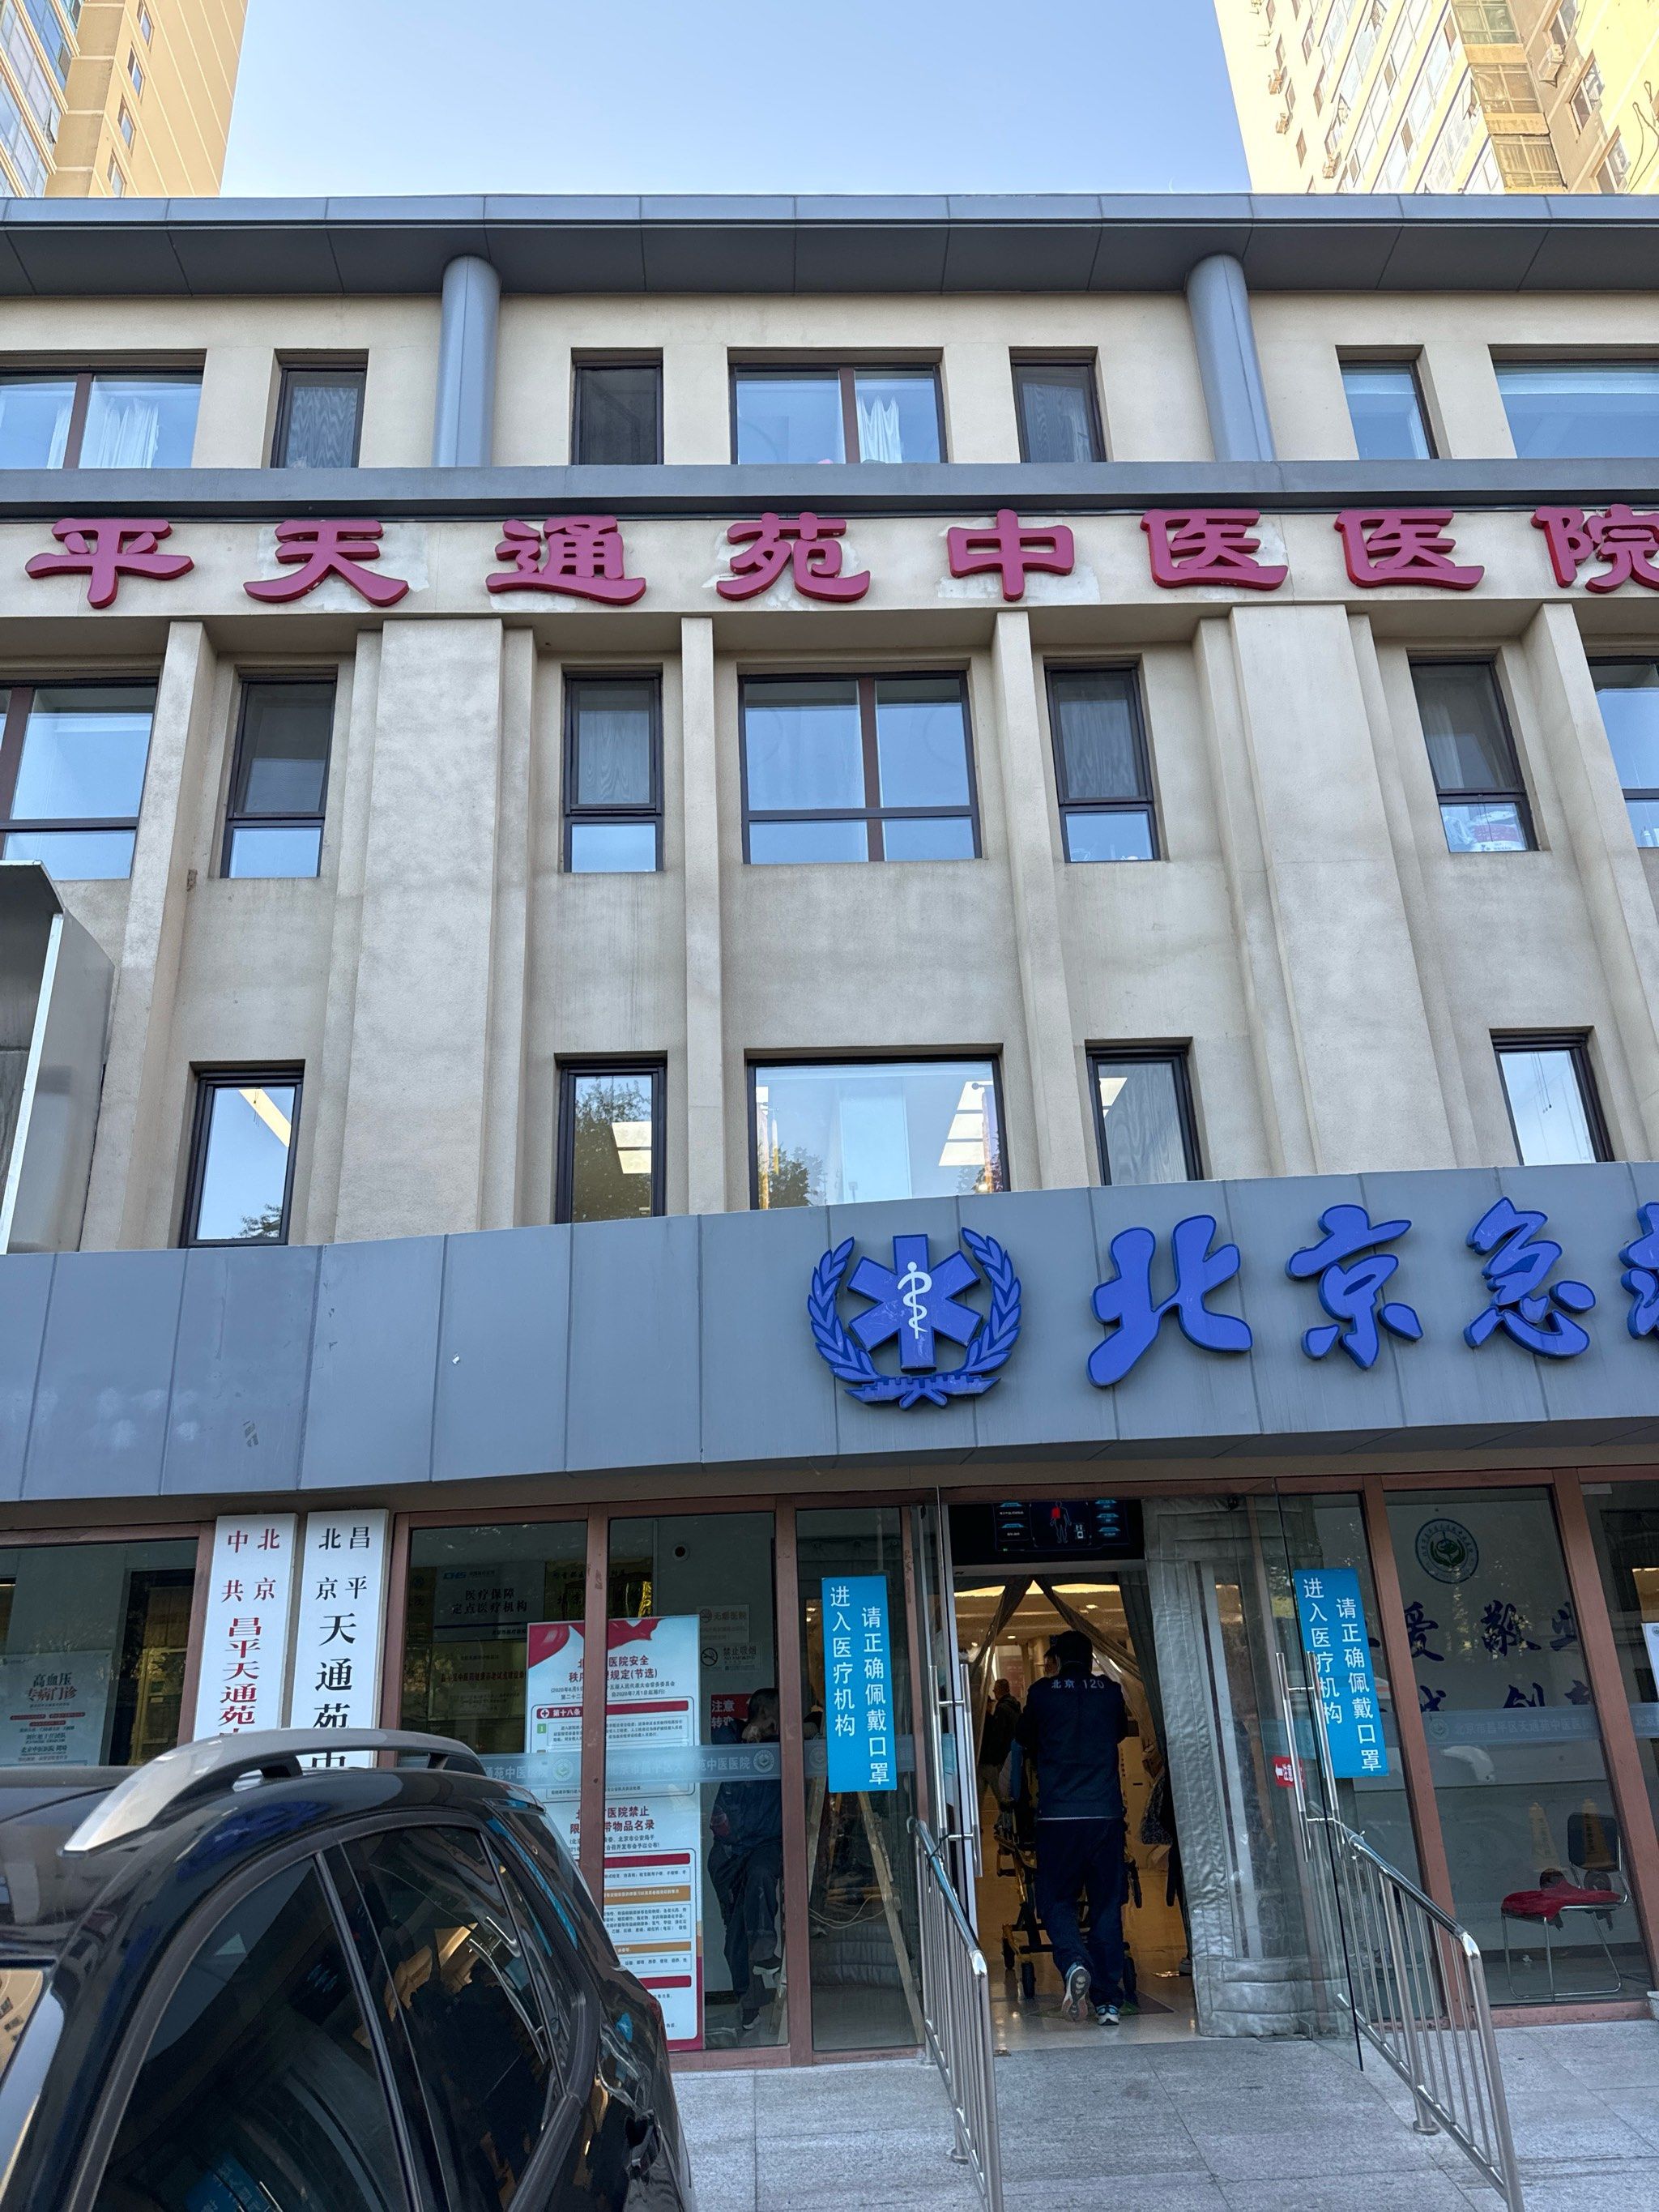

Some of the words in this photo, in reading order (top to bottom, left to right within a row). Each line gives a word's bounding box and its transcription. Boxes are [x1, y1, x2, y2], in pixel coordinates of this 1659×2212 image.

[25, 504, 1659, 609] 平天通苑中医医院
[466, 1588, 514, 1600] 医疗保障
[452, 1600, 527, 1615] 定点医疗机构
[1303, 1578, 1342, 1725] 进入医疗机构
[830, 1586, 855, 1737] 进入医疗机构
[33, 1672, 72, 1687] 高血压
[219, 1616, 262, 1736] 昌平天通苑
[1051, 1679, 1076, 1689] 北京
[1083, 1679, 1105, 1689] 120
[1336, 1598, 1382, 1772] 请正确佩戴口罩
[28, 1686, 78, 1702] 专病门诊
[862, 1606, 890, 1785] 请正确佩戴口罩
[553, 1708, 582, 1717] 第十八条
[712, 1698, 736, 1712] 注意
